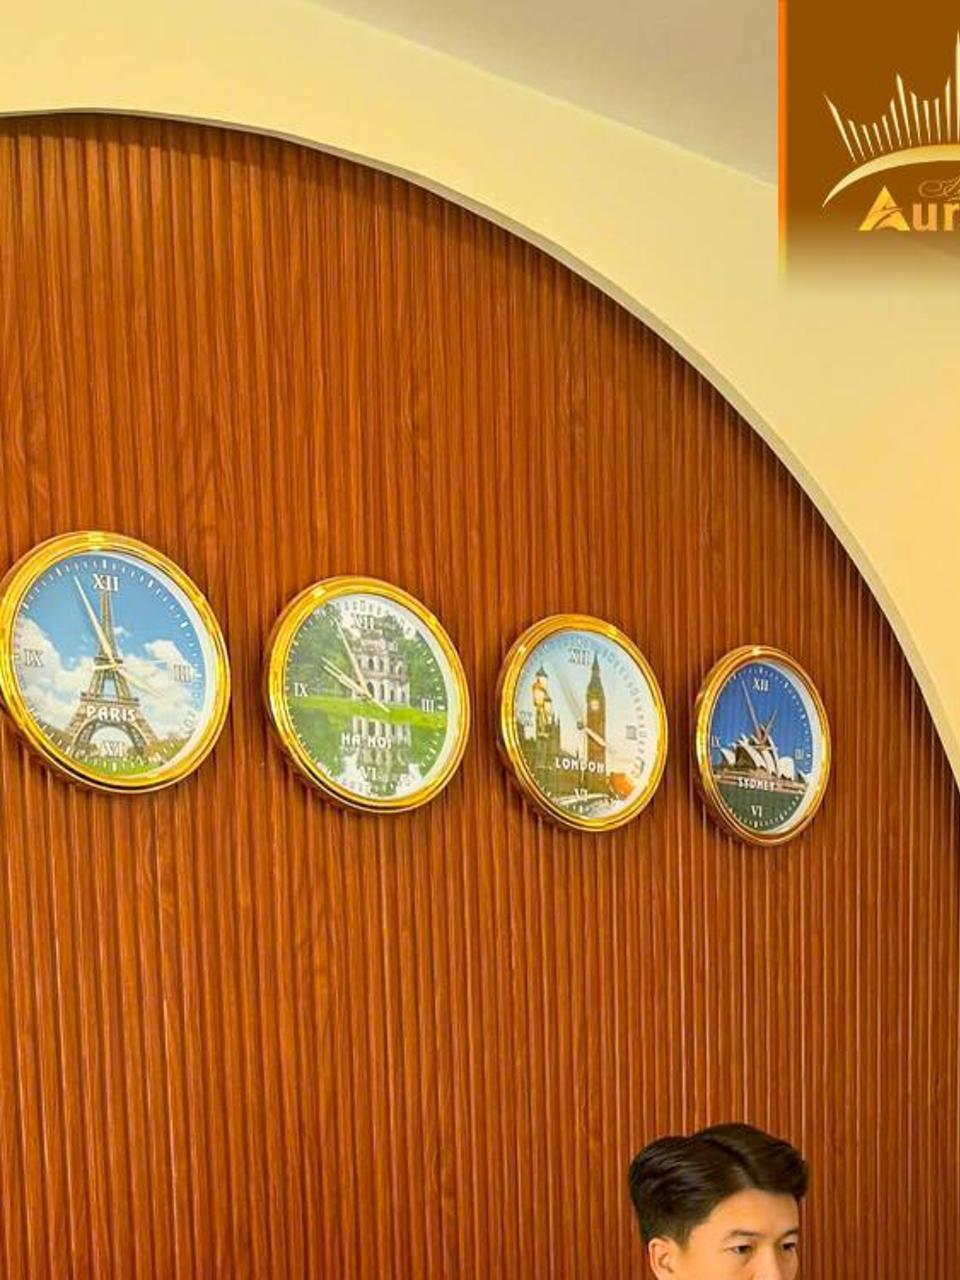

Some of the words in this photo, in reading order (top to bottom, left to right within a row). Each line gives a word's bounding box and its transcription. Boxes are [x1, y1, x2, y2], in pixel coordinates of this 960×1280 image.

[93, 574, 119, 592] XII
[753, 677, 769, 692] XII
[86, 705, 136, 723] PARIS
[555, 757, 606, 773] LONDON
[738, 778, 776, 792] SYDNEY
[751, 804, 763, 818] VI
